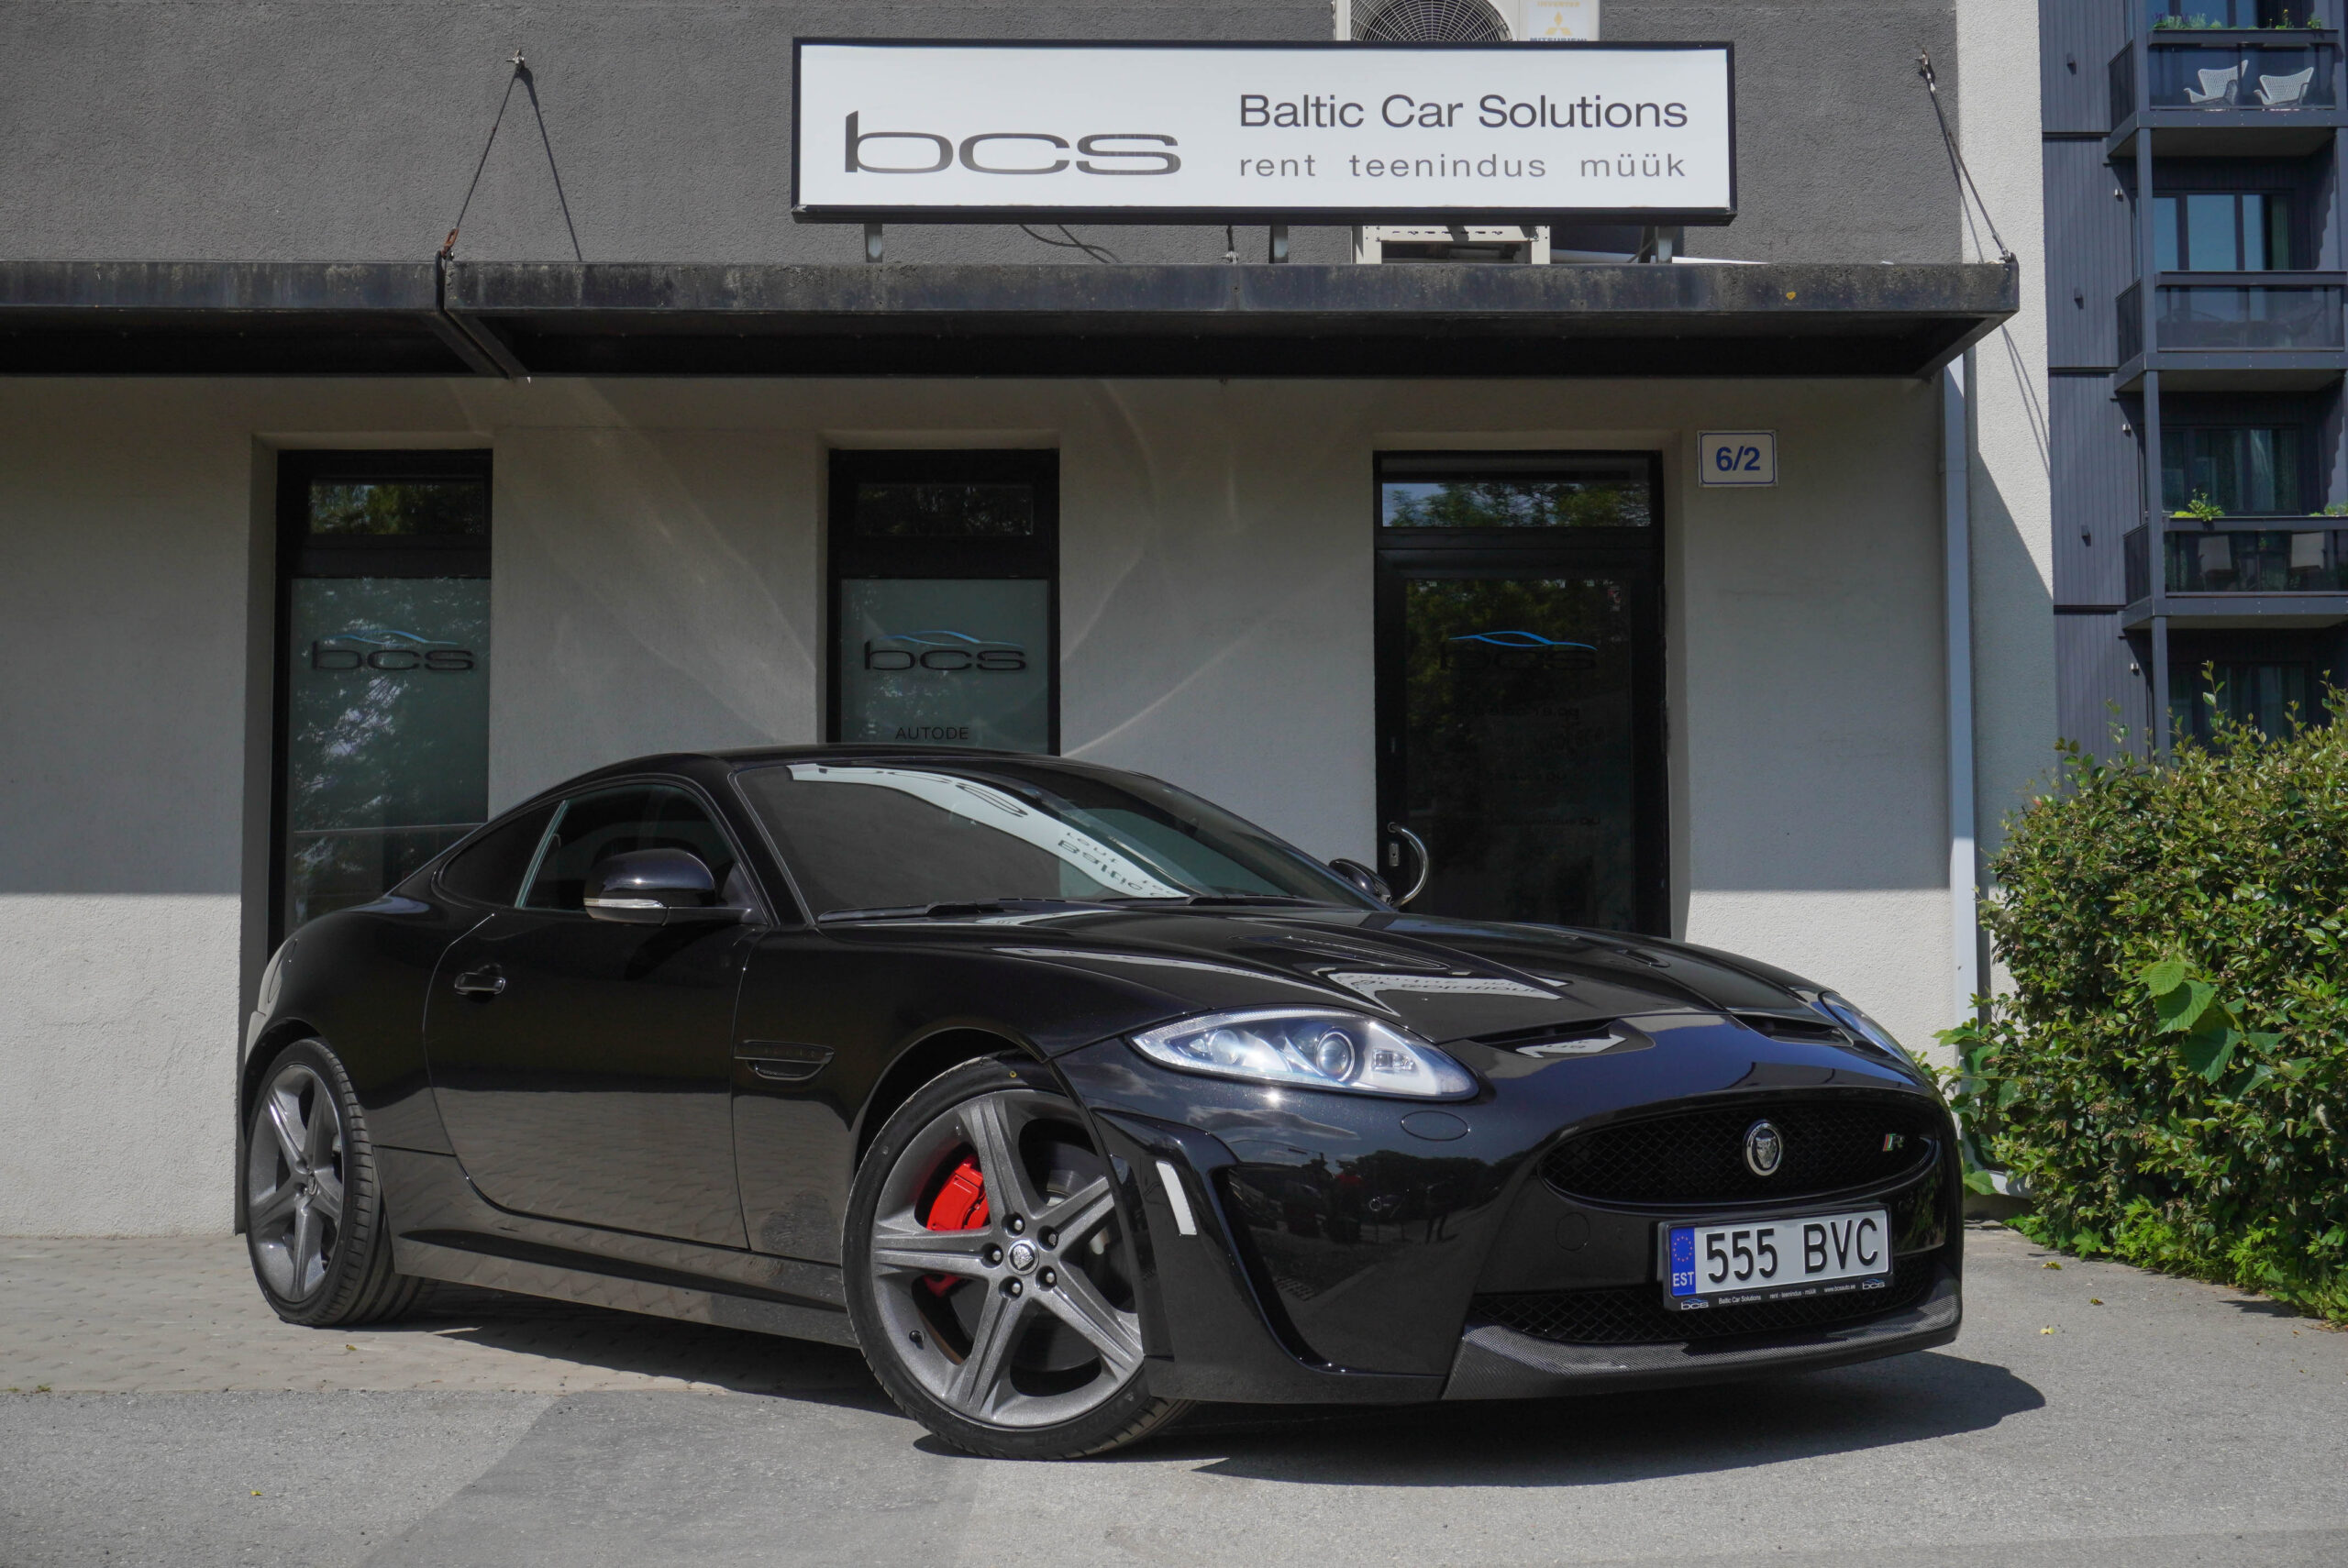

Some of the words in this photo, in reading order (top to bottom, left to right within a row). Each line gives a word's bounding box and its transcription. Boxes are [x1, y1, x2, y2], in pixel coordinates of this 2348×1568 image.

[1241, 94, 1364, 128] Baltic
[1382, 94, 1463, 128] Car
[1479, 94, 1687, 128] Solutions
[846, 111, 1180, 175] bcs
[1241, 154, 1314, 177] rent
[1349, 153, 1545, 178] teenindus
[1582, 153, 1685, 177] müük
[1715, 446, 1761, 471] 6/2
[312, 641, 475, 672] bcs
[864, 641, 1027, 671] bcs
[894, 726, 969, 740] AUTODE
[1705, 1228, 1778, 1284] 555
[1802, 1217, 1878, 1275] BVC
[1672, 1271, 1695, 1287] EST
[1862, 1281, 1886, 1290] bcs
[1680, 1301, 1710, 1310] bcs
[1718, 1297, 1732, 1305] Baltic
[1741, 1295, 1762, 1303] Solutions
